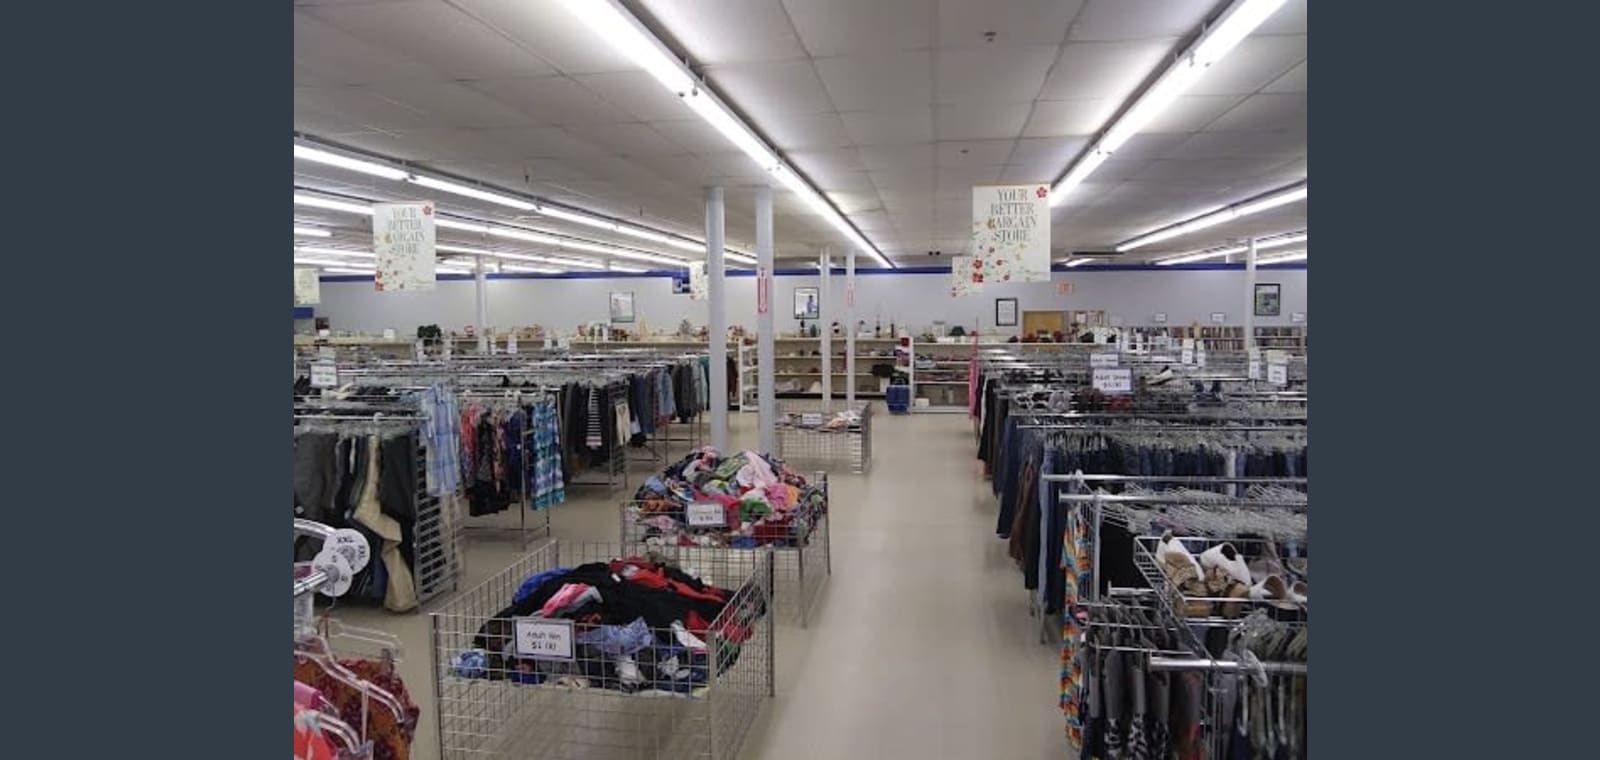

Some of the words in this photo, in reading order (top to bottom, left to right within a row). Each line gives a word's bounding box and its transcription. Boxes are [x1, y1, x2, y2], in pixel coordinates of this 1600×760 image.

[997, 188, 1027, 201] YOUR
[990, 202, 1035, 216] BETTER
[994, 229, 1031, 242] STORE
